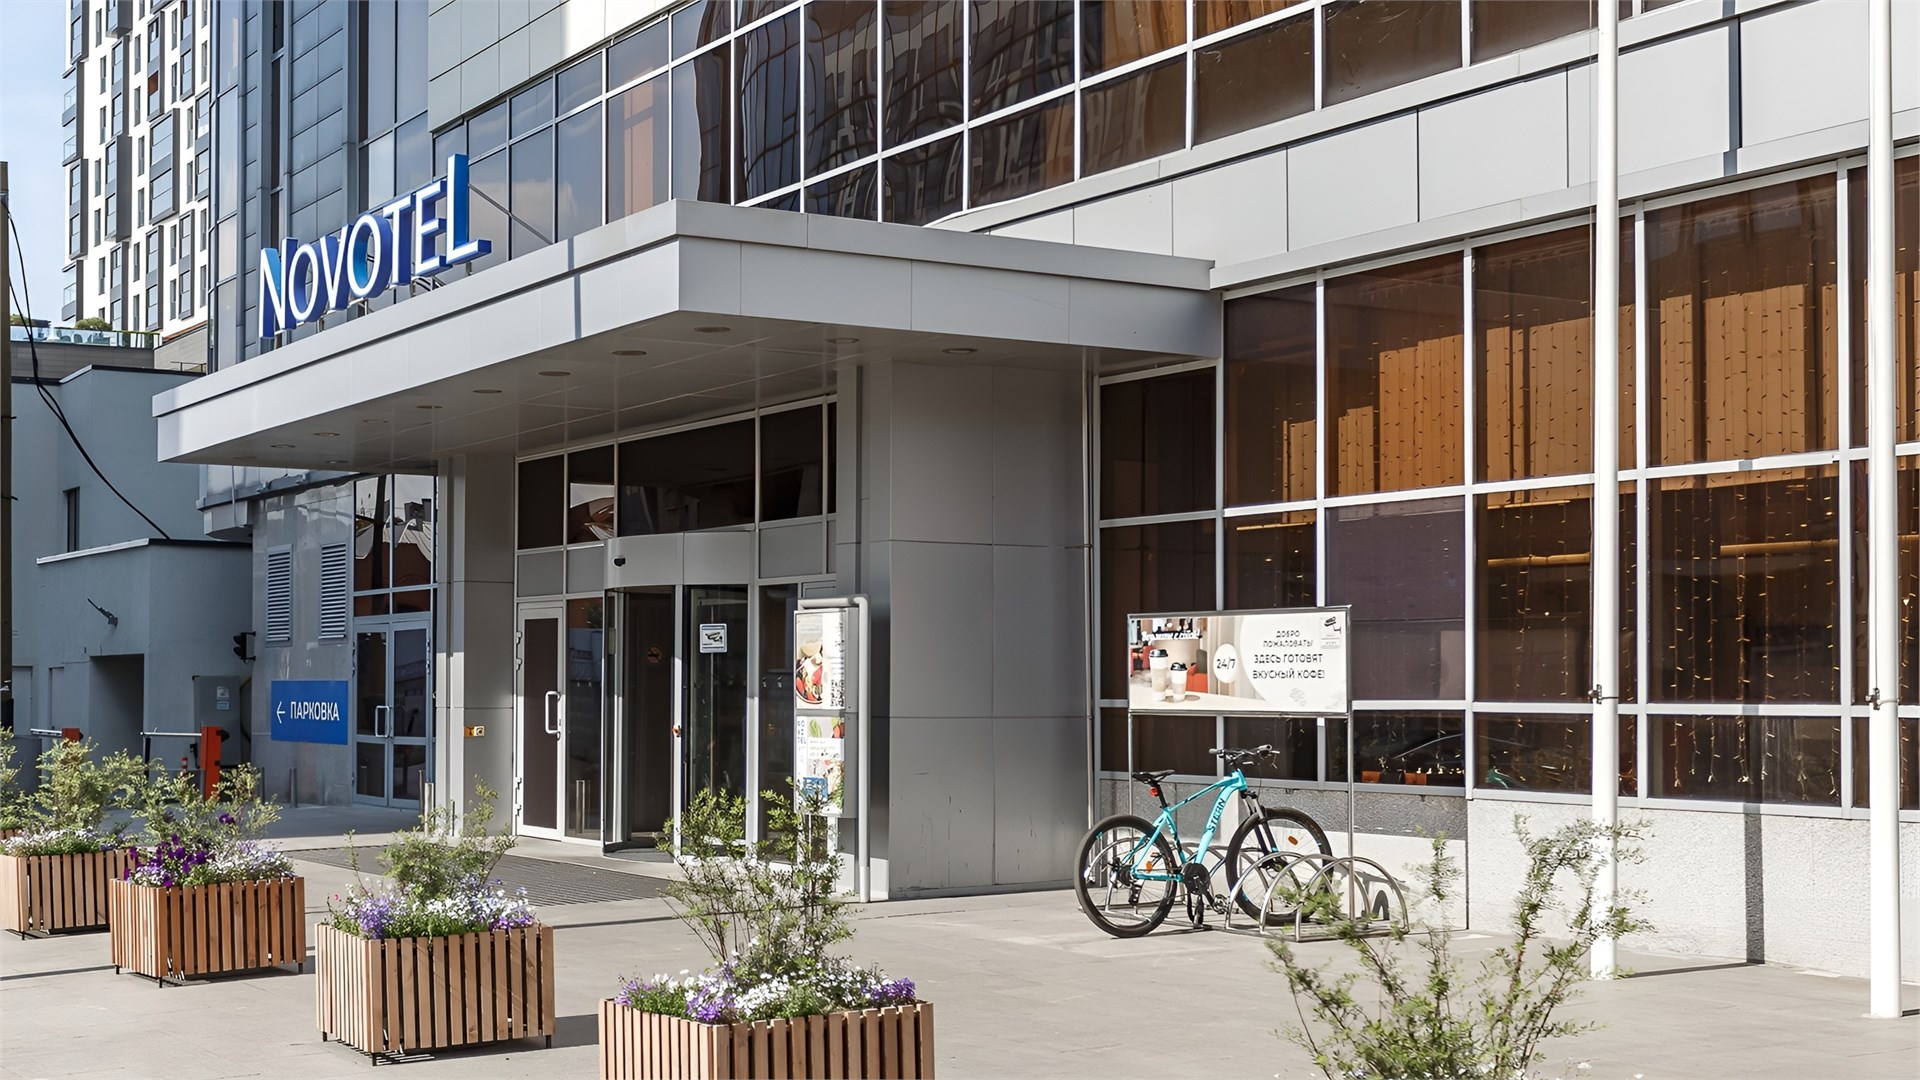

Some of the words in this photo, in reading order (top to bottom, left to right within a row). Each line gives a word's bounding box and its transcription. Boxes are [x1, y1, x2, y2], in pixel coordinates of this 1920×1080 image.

[259, 153, 492, 338] NOVOTEL
[1275, 630, 1301, 638] ДОБРО
[1216, 657, 1236, 670] 24/7
[1253, 653, 1281, 664] ЗДЕСЬ
[1283, 653, 1323, 663] ГОТОВЯТ
[1252, 667, 1295, 679] ВКУСНЫЙ
[1297, 669, 1325, 679] КОФЕ!
[290, 701, 340, 721] ПАРКОВКА
